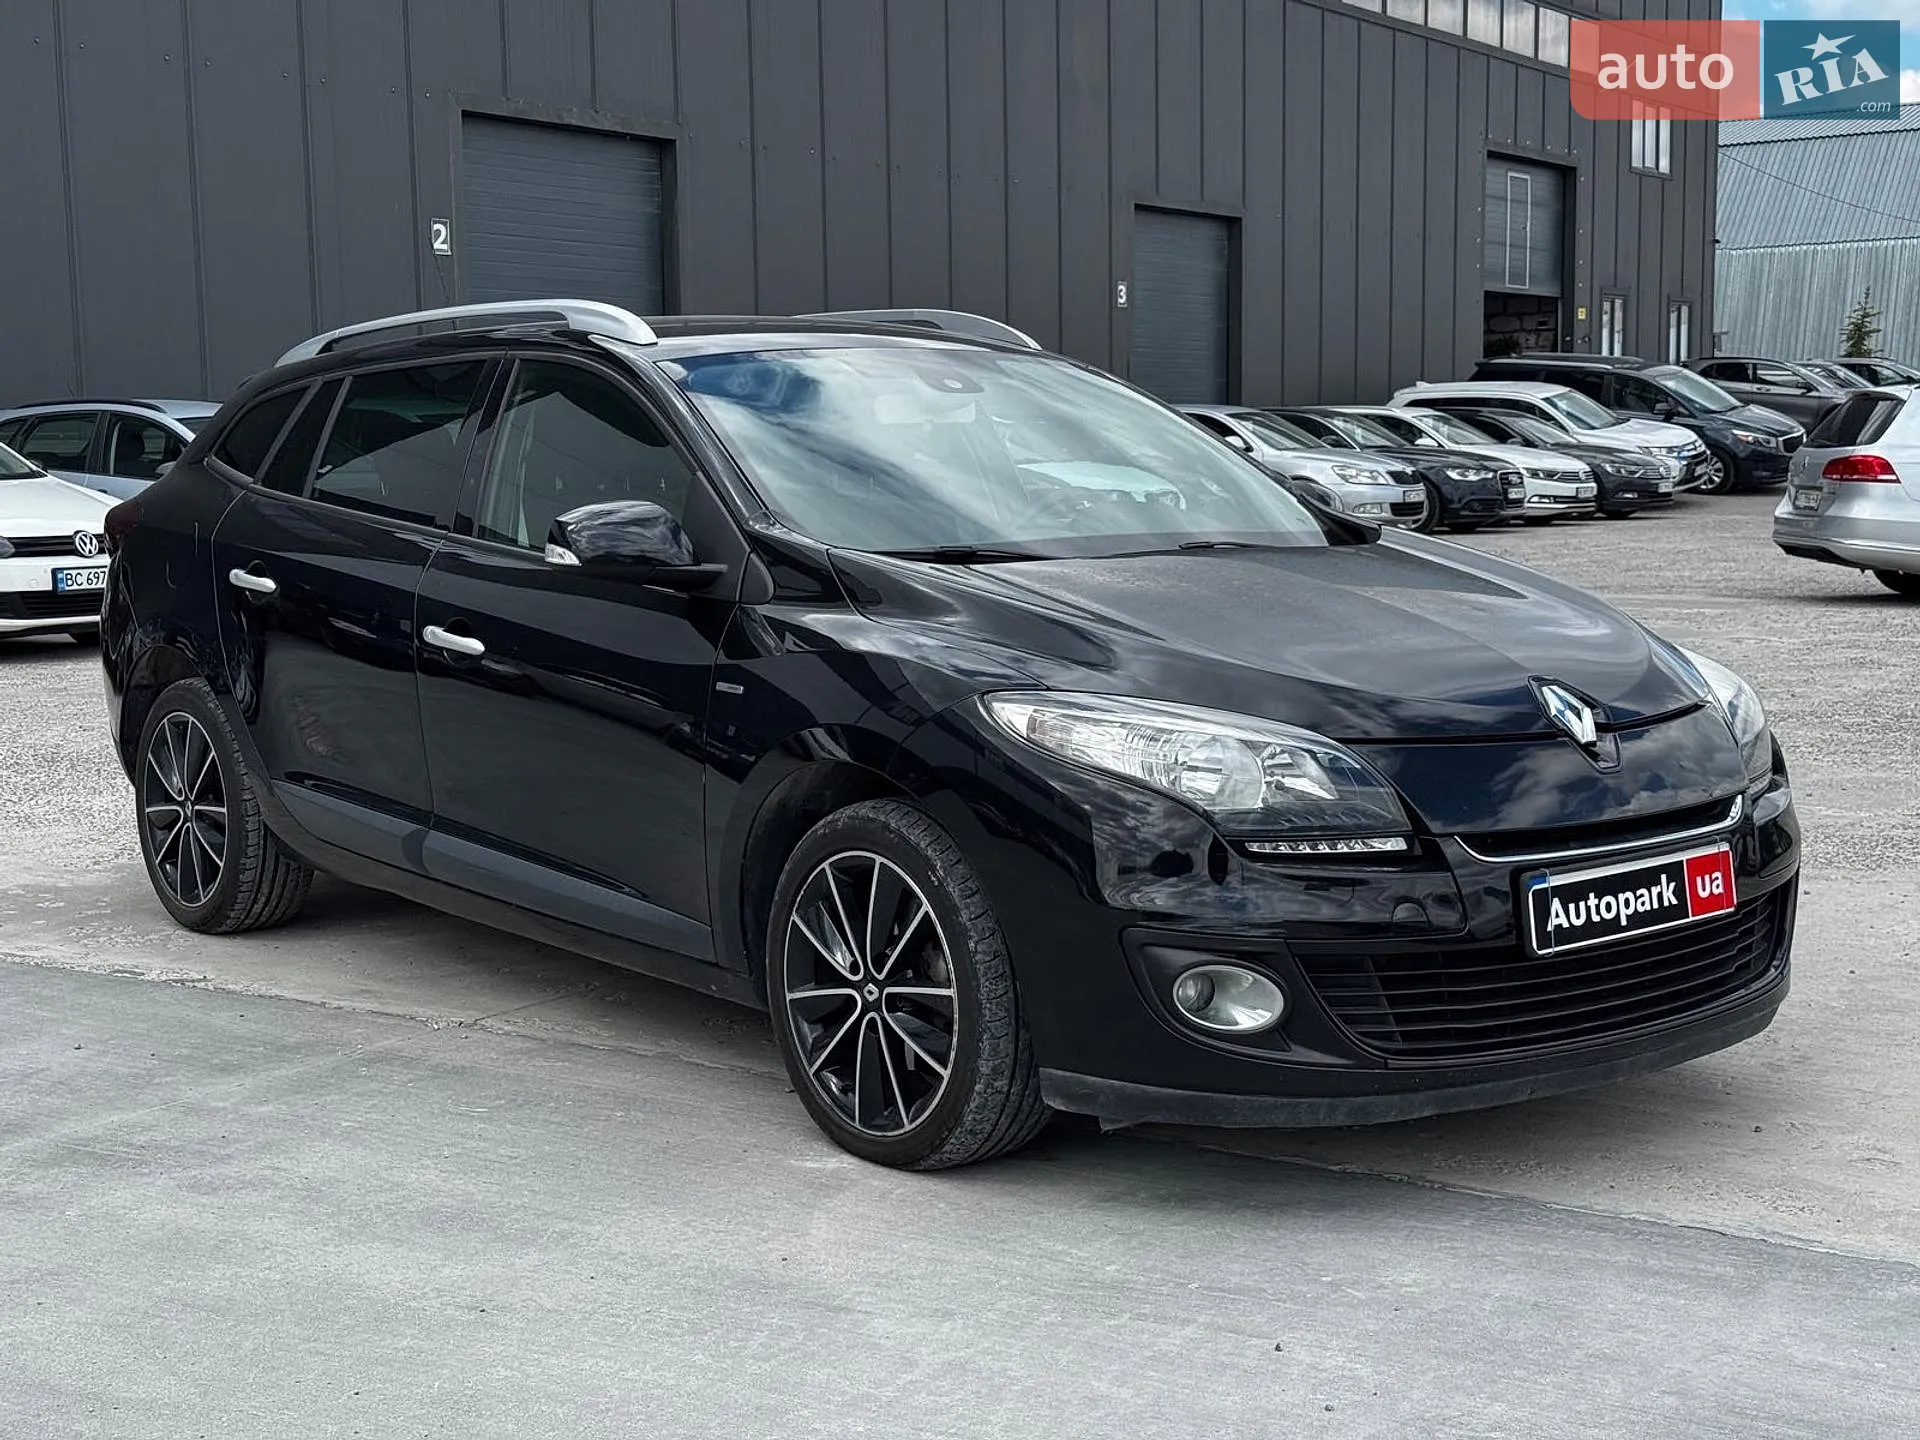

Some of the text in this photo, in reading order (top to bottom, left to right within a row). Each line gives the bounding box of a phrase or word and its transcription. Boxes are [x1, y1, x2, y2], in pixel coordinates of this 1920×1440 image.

[433, 223, 448, 250] 2
[1117, 284, 1127, 304] 3
[64, 570, 107, 587] BC 697
[1546, 870, 1725, 932] Autopark ua
